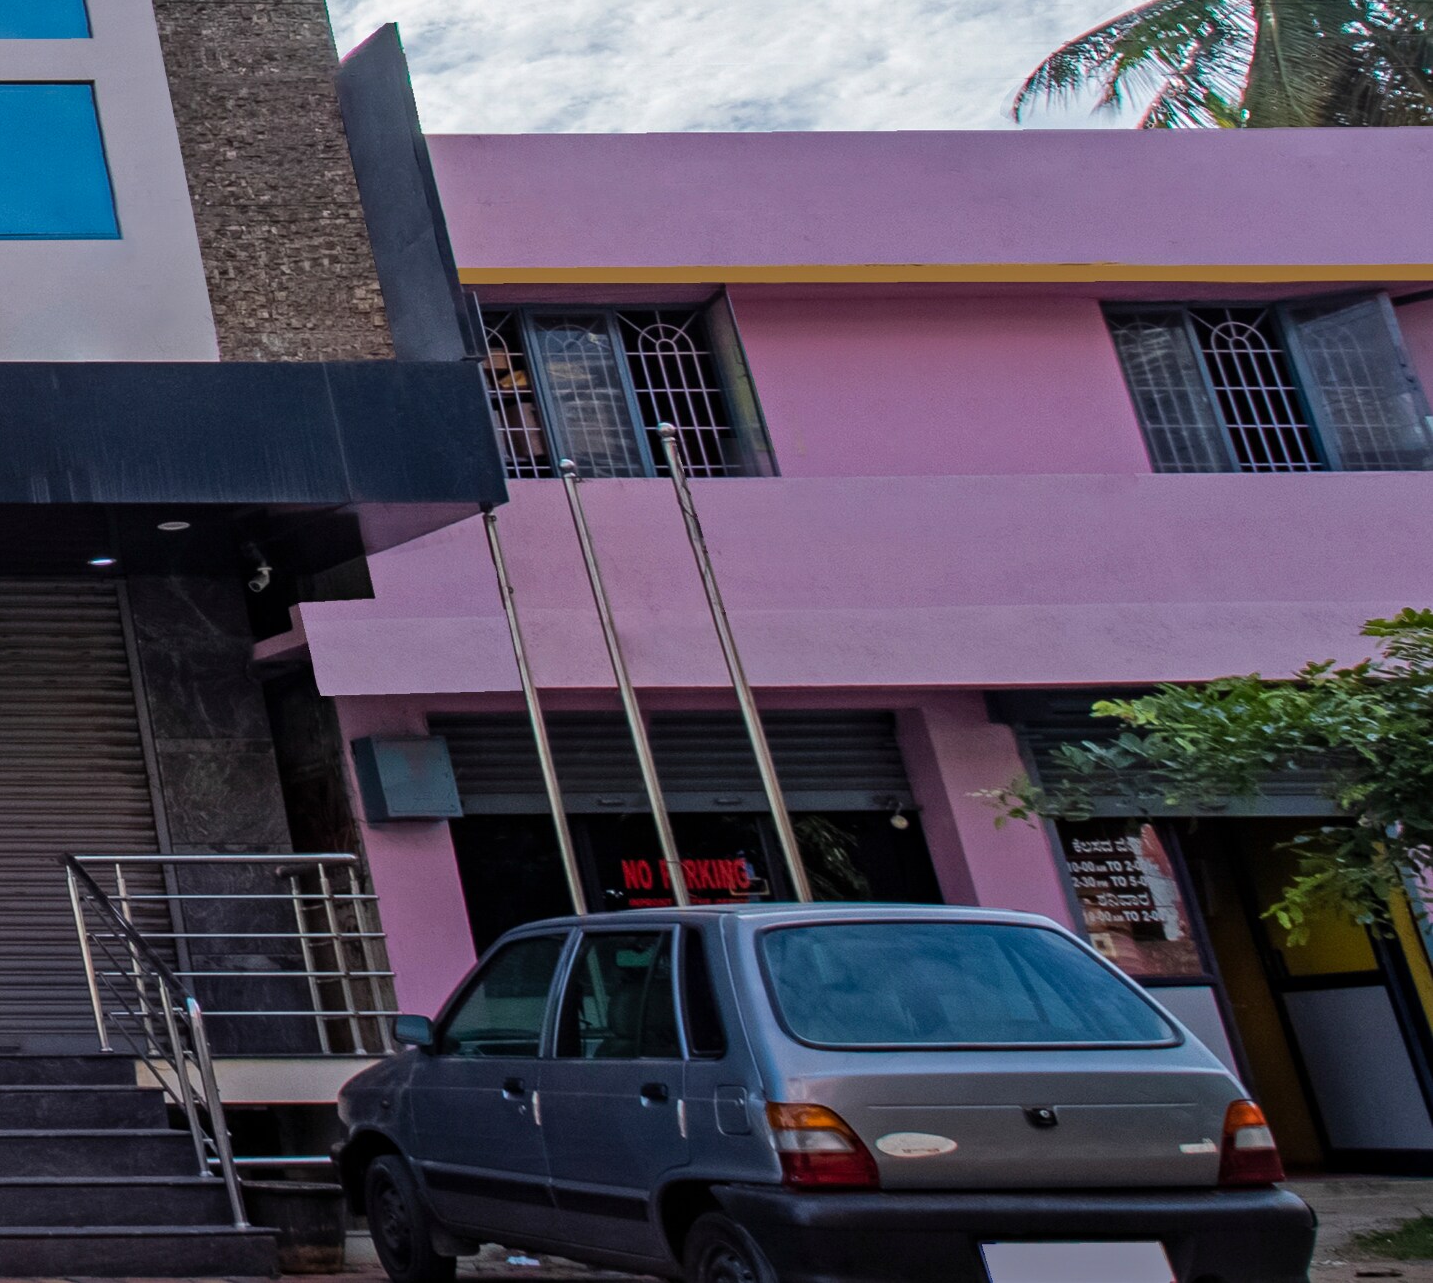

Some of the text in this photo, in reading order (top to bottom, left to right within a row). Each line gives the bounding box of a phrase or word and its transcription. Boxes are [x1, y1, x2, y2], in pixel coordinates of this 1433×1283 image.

[1105, 860, 1122, 872] TO
[621, 858, 751, 890] NO PRKING
[1110, 875, 1127, 888] TO
